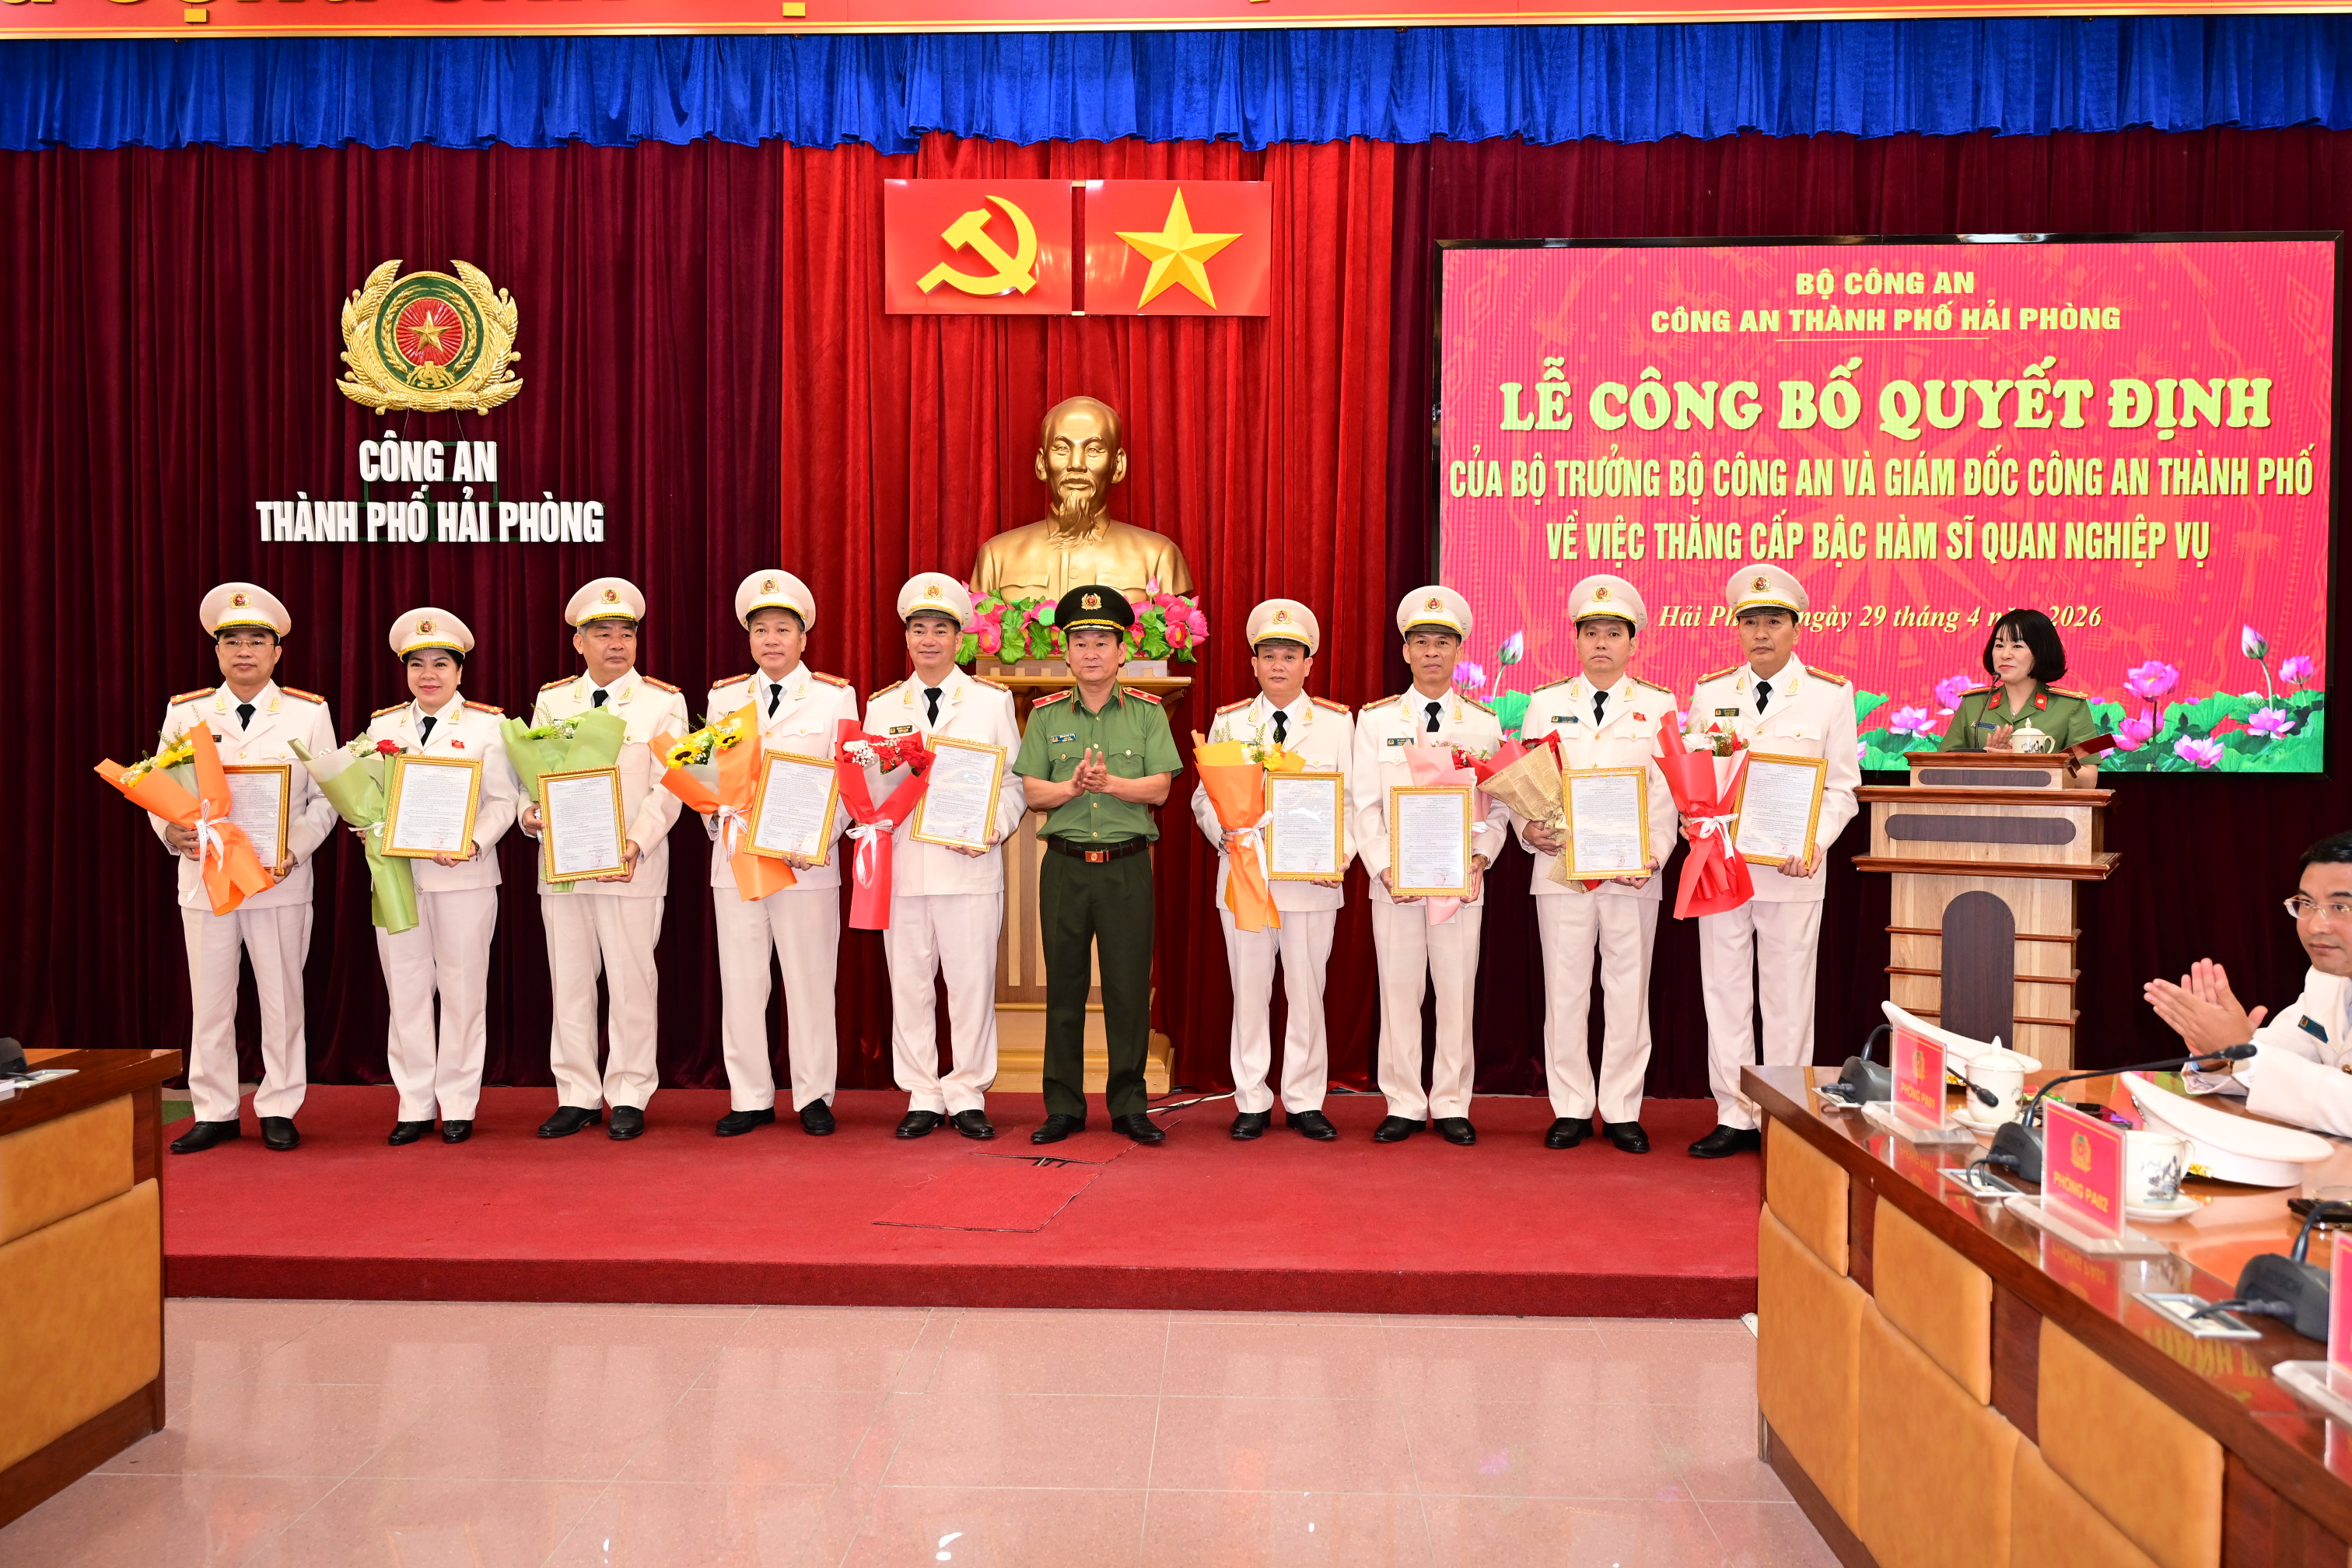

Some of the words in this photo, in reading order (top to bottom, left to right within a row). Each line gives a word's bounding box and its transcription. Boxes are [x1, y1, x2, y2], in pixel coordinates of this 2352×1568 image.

[1797, 268, 1834, 299] BỘ
[1845, 268, 1924, 295] CÔNG
[1934, 271, 1974, 293] AN
[1652, 306, 1730, 332] CÔNG
[1739, 310, 1780, 331] AN
[1789, 305, 1885, 331] THÀNH
[1895, 301, 1953, 331] PHỐ
[1962, 299, 2010, 330] HẢI
[2021, 303, 2120, 330] PHÒNG
[1500, 357, 1572, 430] LỄ
[1589, 366, 1762, 430] CÔNG
[1779, 357, 1862, 429] BỐ
[1879, 356, 2093, 440] QUYẾT
[2109, 378, 2272, 439] ĐỊNH
[359, 430, 444, 481] CÔNG
[453, 441, 497, 481] AN
[1450, 445, 1503, 497] CỦA
[1511, 452, 1545, 505] BỘ
[1555, 443, 1660, 497] TRƯỞNG
[1670, 452, 1703, 504] BỘ
[1713, 452, 1787, 496] CÔNG
[1795, 459, 1832, 495] AN
[1842, 450, 1875, 495] VÀ
[1885, 451, 1955, 496] GIÁM
[1964, 445, 2018, 495] ĐỐC
[2028, 450, 2102, 495] CÔNG
[2111, 458, 2148, 495] AN
[2159, 450, 2249, 495] THÀNH
[2259, 444, 2314, 495] PHỐ
[256, 492, 358, 541] THÀNH
[367, 485, 429, 542] PHỐ
[438, 486, 490, 541] HẢI
[499, 492, 604, 542] PHÒNG
[1546, 509, 1578, 559] VỀ
[1586, 515, 1644, 568] VIỆC
[1655, 515, 1741, 559] THĂNG
[1751, 509, 1803, 559] CẤP
[1813, 514, 1866, 567] BẬC
[1876, 514, 1937, 558] HÀM
[1947, 515, 1974, 559] SĨ
[1982, 522, 2056, 564] QUAN
[2065, 514, 2165, 567] NGHIỆP
[2175, 522, 2209, 567] VỤ
[1658, 606, 1702, 626] Hải
[1800, 605, 1852, 632] ngày
[1860, 606, 1886, 625] 29
[1894, 606, 1960, 632] tháng
[1967, 607, 1980, 626] 4
[2050, 606, 2101, 626] 2026
[2053, 1171, 2084, 1199] PHÒNG
[2085, 1188, 2109, 1213] PA02
